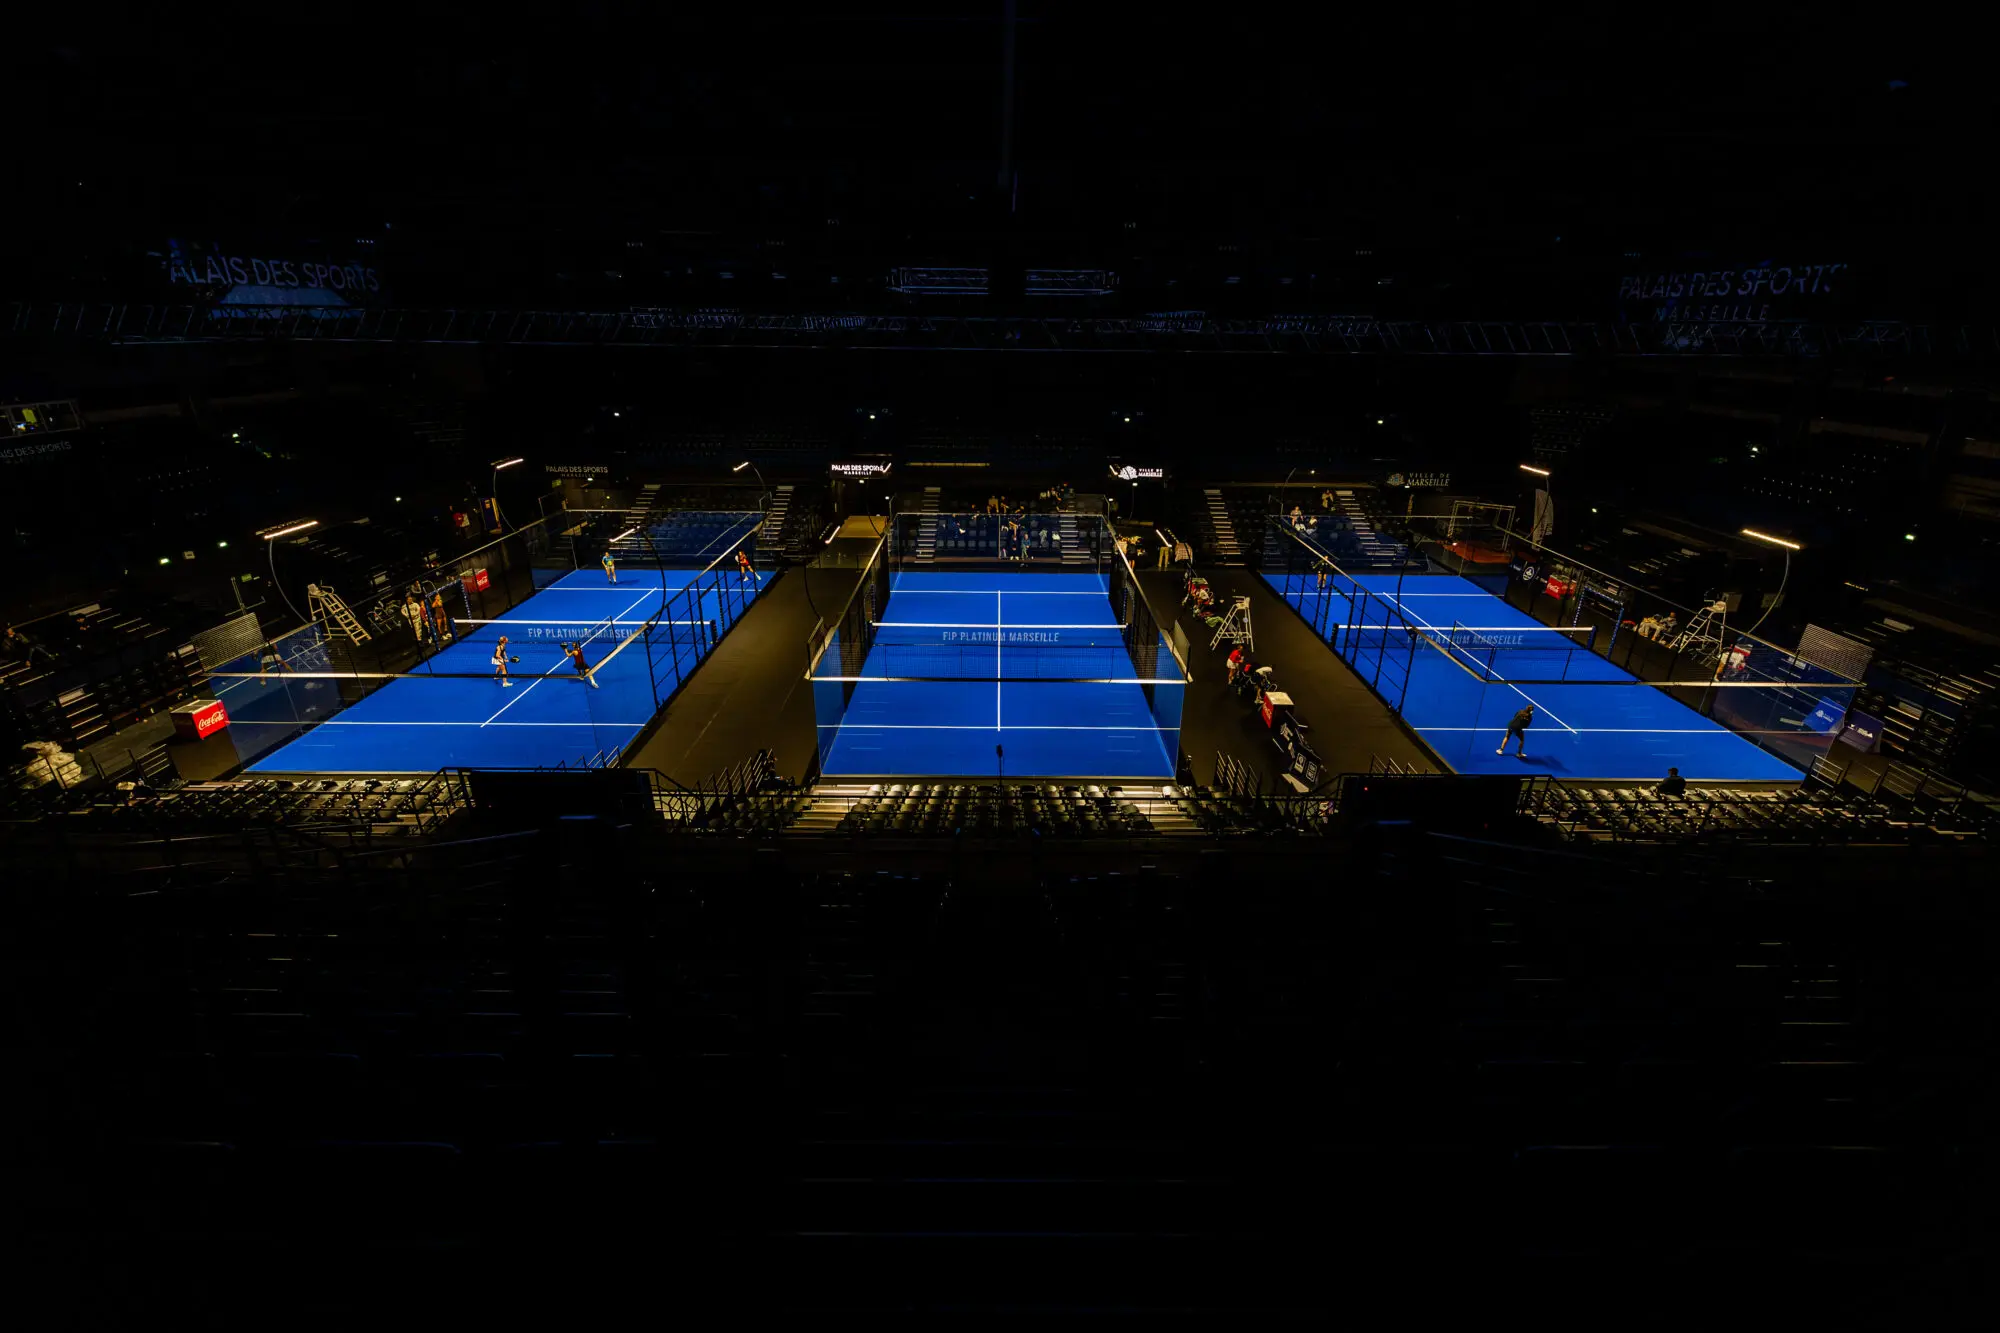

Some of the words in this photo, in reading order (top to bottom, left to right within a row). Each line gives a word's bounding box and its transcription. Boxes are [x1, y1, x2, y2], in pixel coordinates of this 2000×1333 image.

[169, 254, 249, 286] ALAIS
[250, 256, 300, 287] DES
[301, 261, 381, 292] SPORTS
[545, 465, 569, 473] PALAIS
[569, 465, 582, 473] DES
[583, 465, 609, 473] SPORTS
[1406, 478, 1451, 486] MARSEILLE
[527, 628, 543, 639] FIP
[545, 628, 593, 639] PLATINUM
[942, 631, 958, 641] FIP
[960, 631, 1006, 642] PLATINUM
[1009, 632, 1060, 642] MARSEILLE
